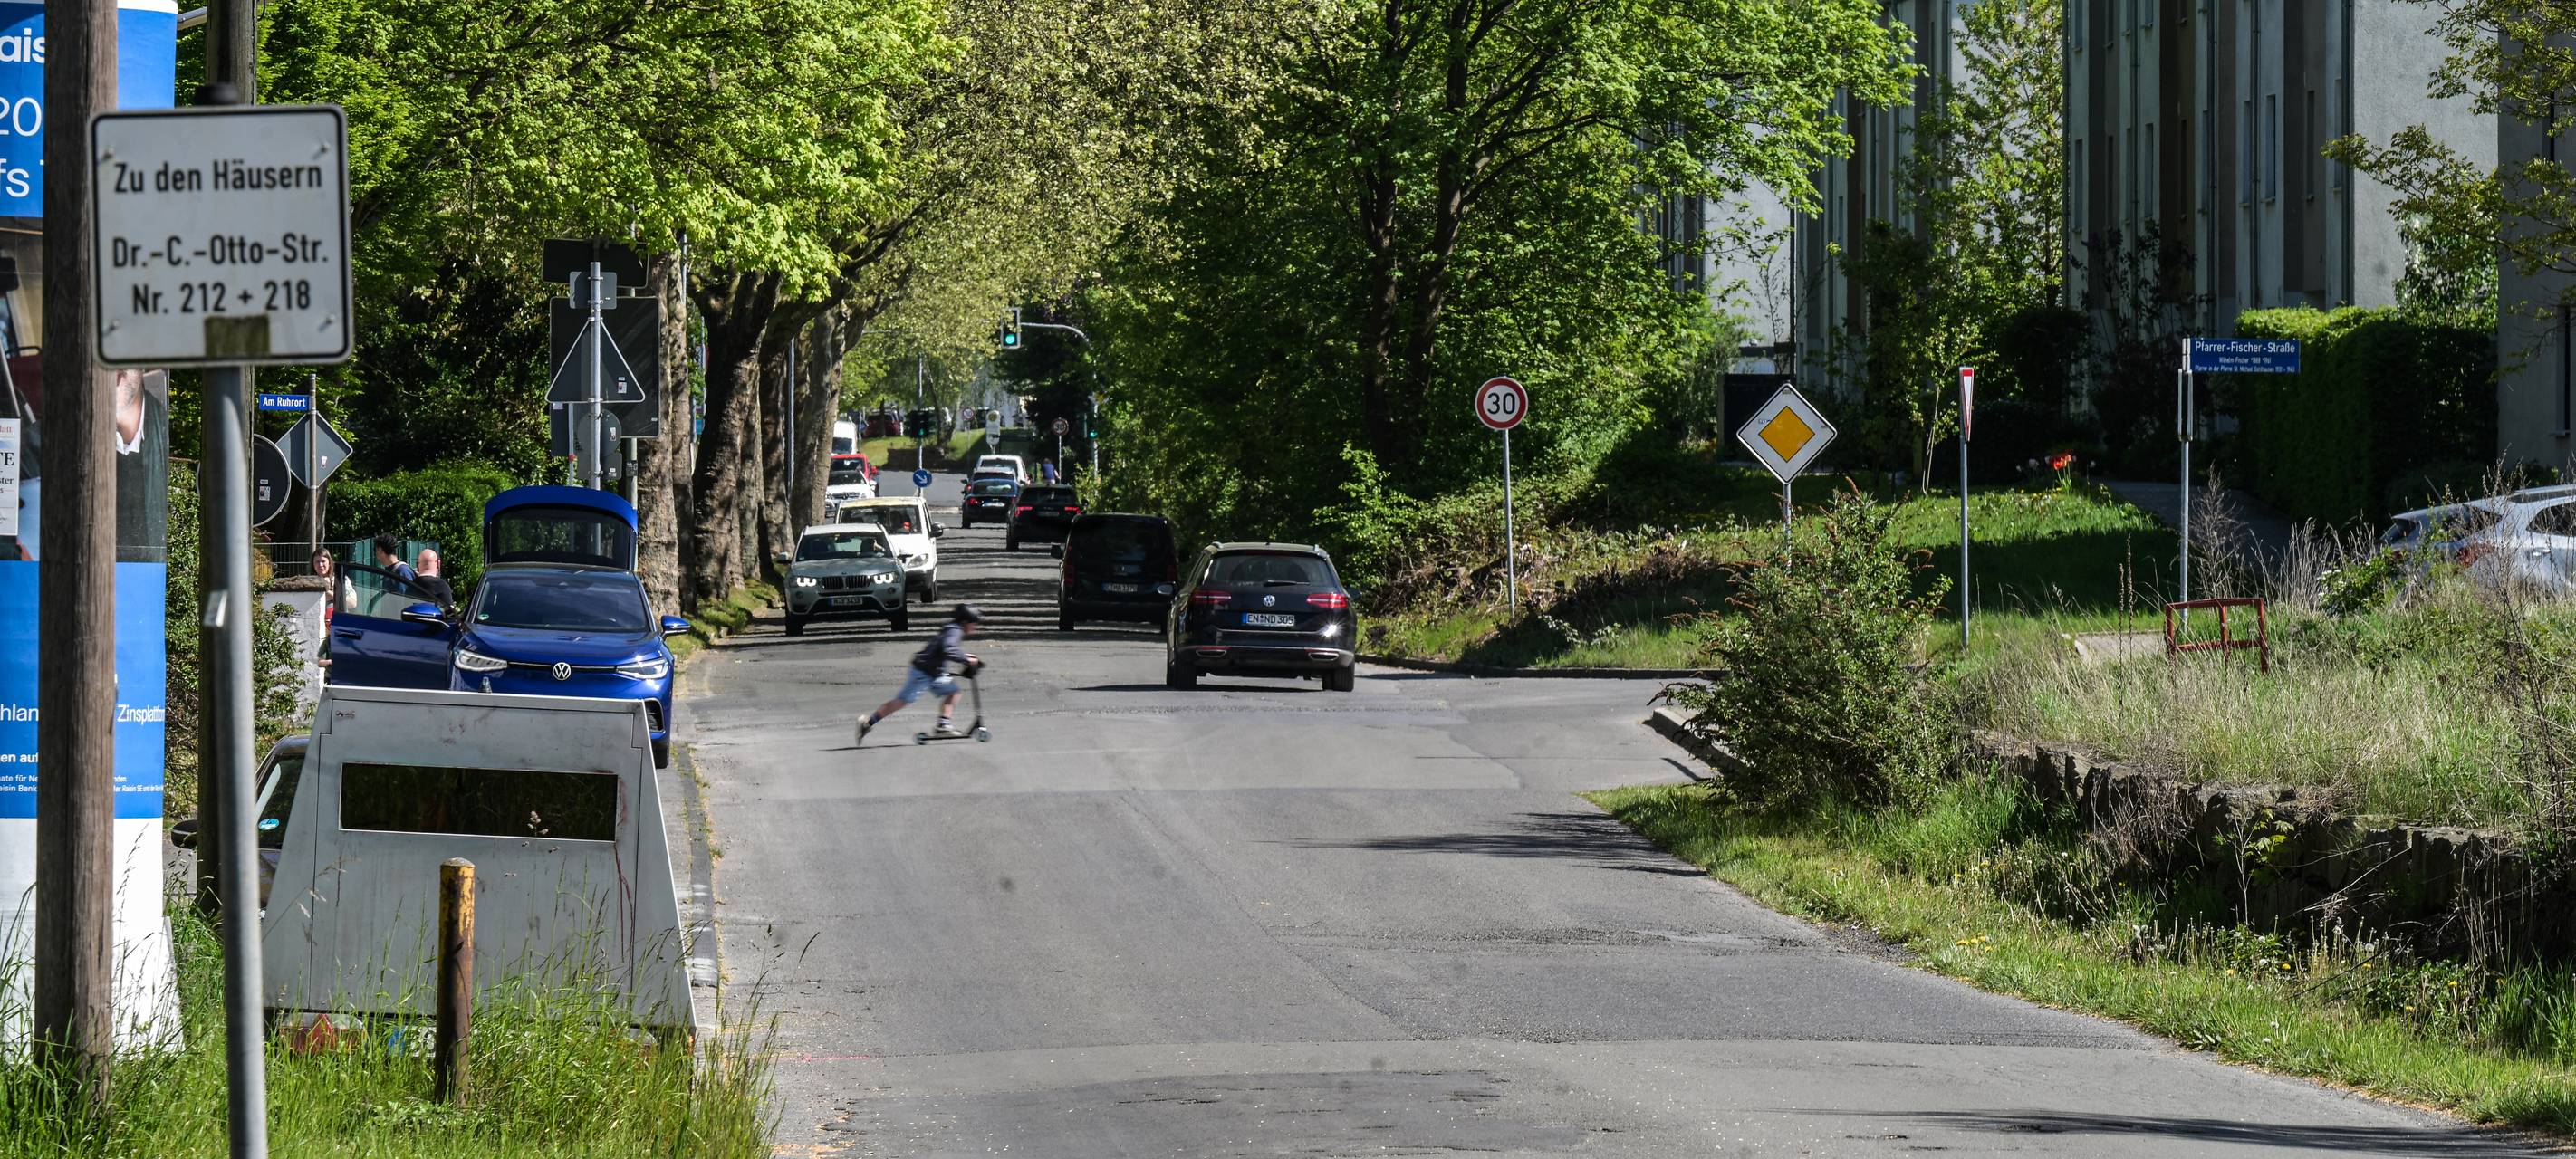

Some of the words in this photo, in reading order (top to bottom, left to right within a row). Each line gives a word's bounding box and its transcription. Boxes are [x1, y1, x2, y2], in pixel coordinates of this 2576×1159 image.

[114, 163, 145, 193] Zu
[155, 161, 202, 192] den
[213, 159, 322, 190] Häusern
[112, 232, 329, 268] Dr.-C.-Otto-Str.
[132, 283, 169, 314] Nr.
[180, 282, 226, 312] 212
[237, 289, 254, 305] +
[264, 279, 312, 311] 218
[2195, 340, 2296, 353] Pfarrer-Fischer-Straße
[263, 397, 274, 407] Am
[277, 397, 305, 407] Ruhrort
[1487, 392, 1515, 415] 30
[0, 453, 14, 466] E
[1247, 614, 1259, 624] EN
[1264, 615, 1276, 624] ND
[1277, 615, 1293, 625] 305
[553, 662, 571, 681] VW
[15, 774, 27, 782] für
[18, 784, 38, 792] Bank
